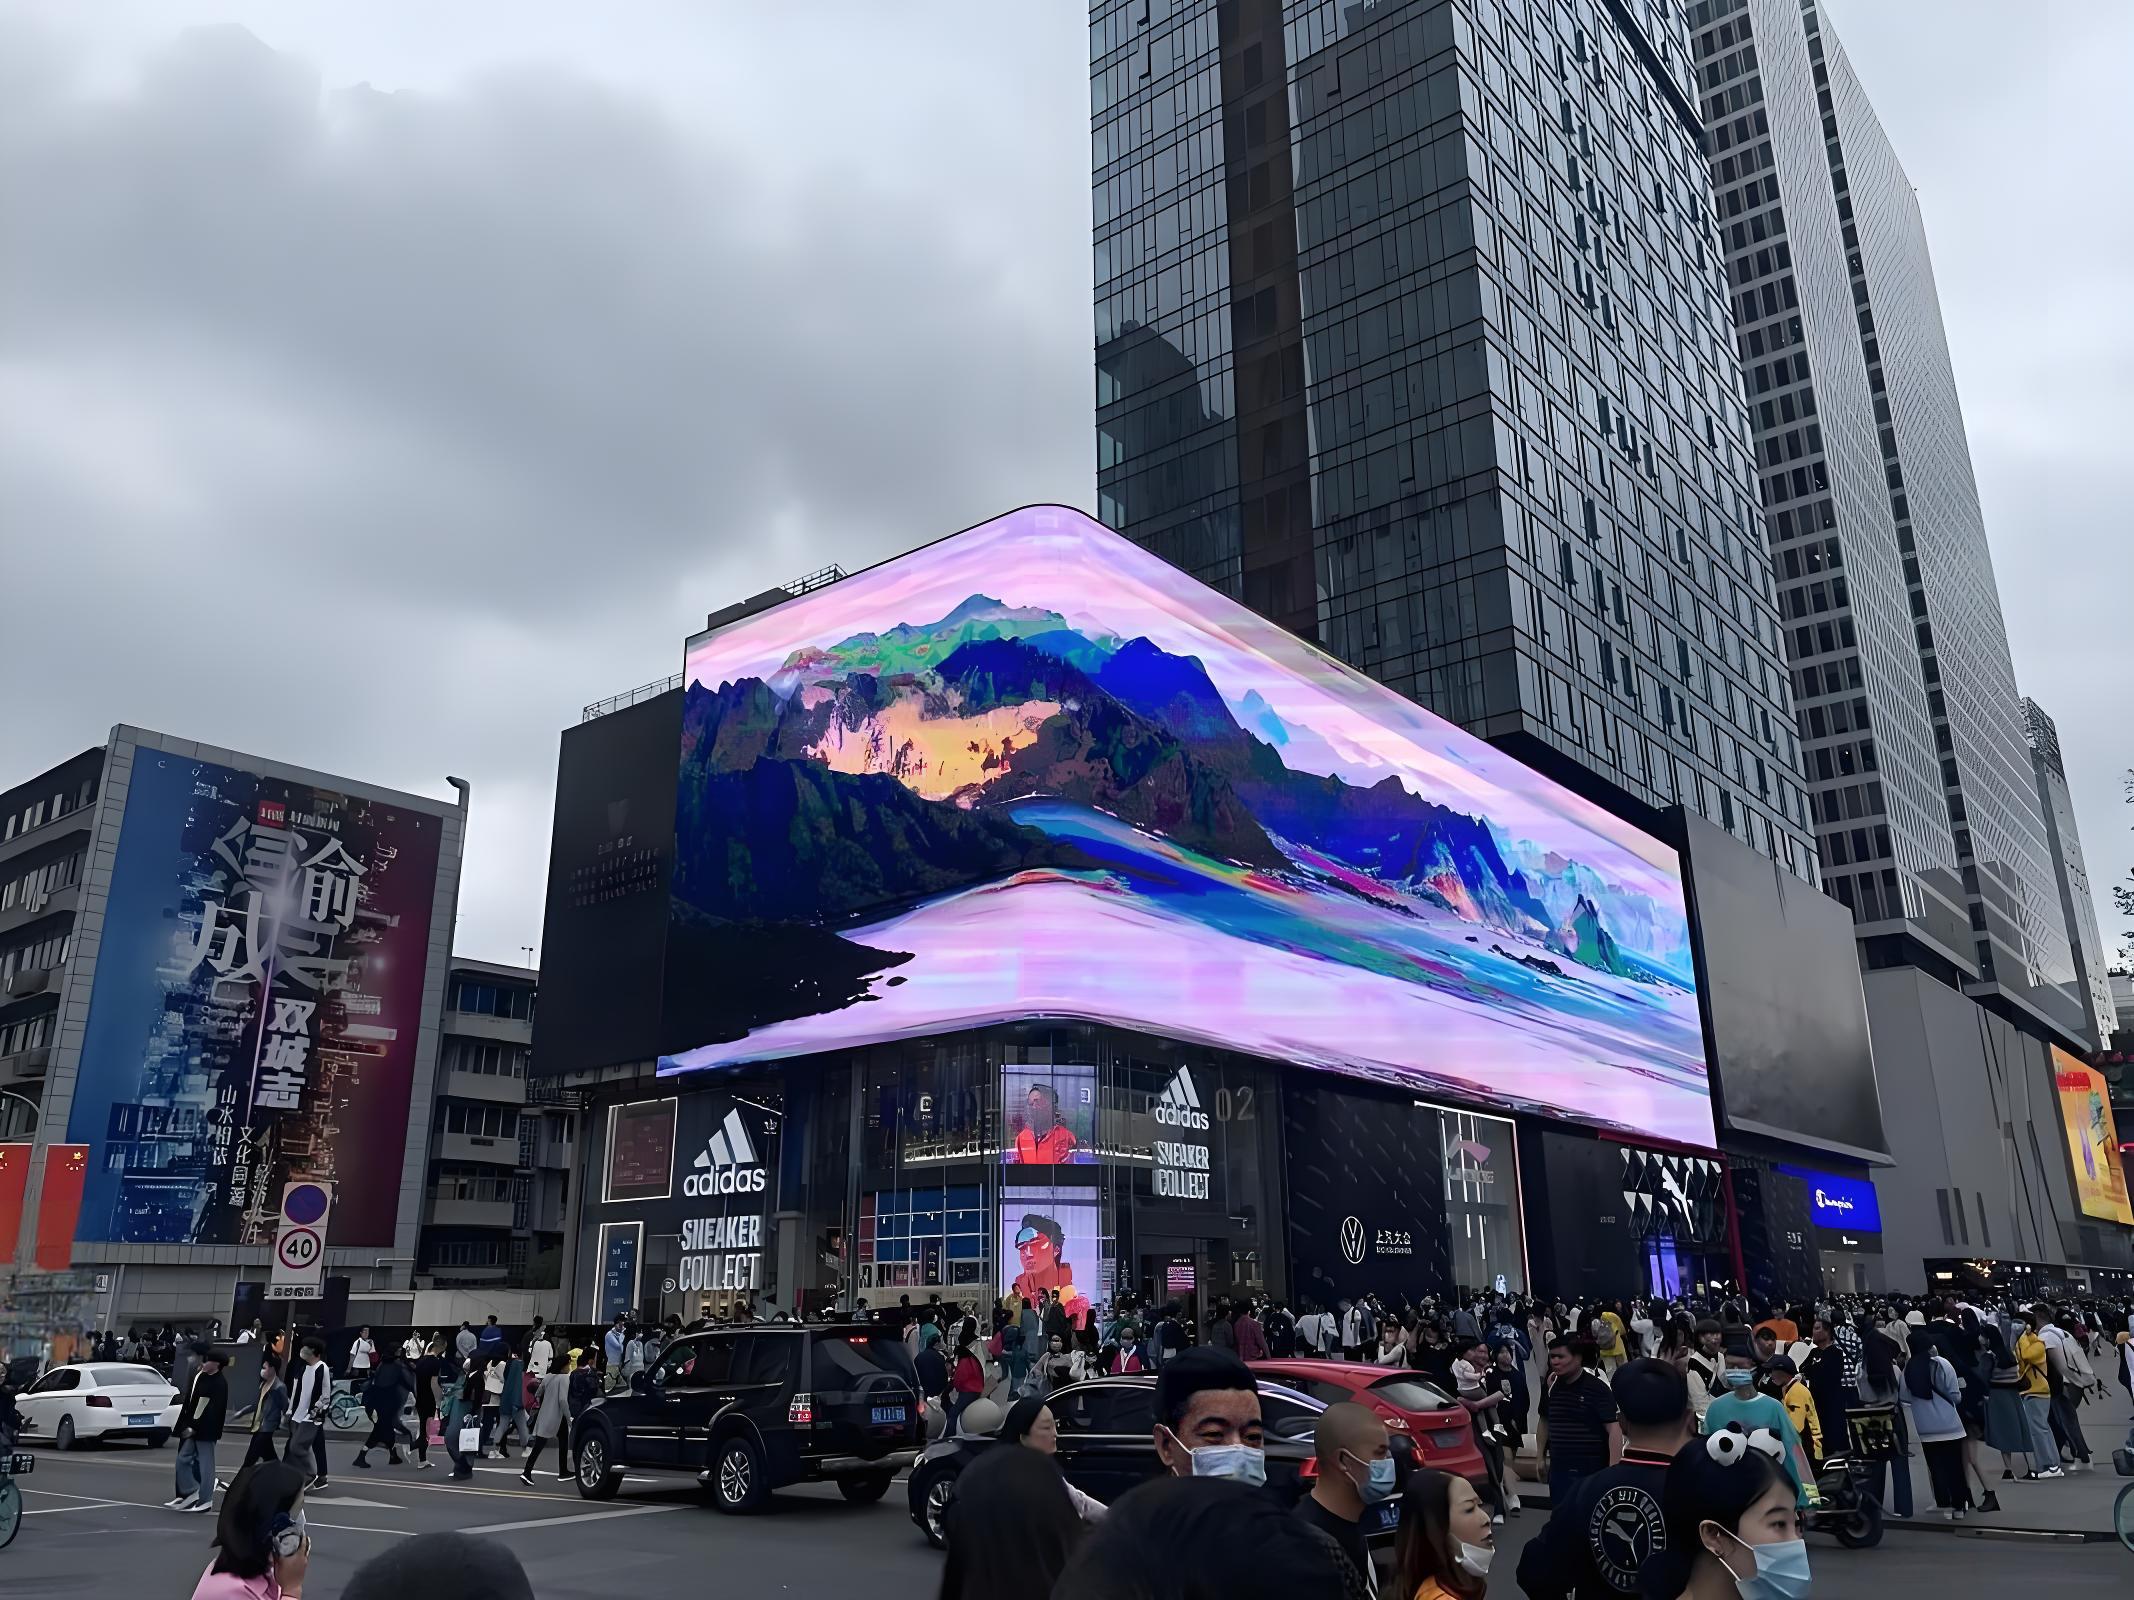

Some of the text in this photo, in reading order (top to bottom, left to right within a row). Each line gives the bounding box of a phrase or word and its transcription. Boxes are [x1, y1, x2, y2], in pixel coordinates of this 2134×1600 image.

[1155, 1101, 1210, 1130] adidas
[1215, 1086, 1256, 1122] 02
[1157, 1141, 1210, 1169] SNEAKER
[683, 1163, 766, 1197] adidas
[1158, 1169, 1210, 1200] COLLECT
[286, 1238, 313, 1259] 40
[681, 1215, 761, 1251] SNEAKER
[679, 1253, 761, 1292] COLLECT
